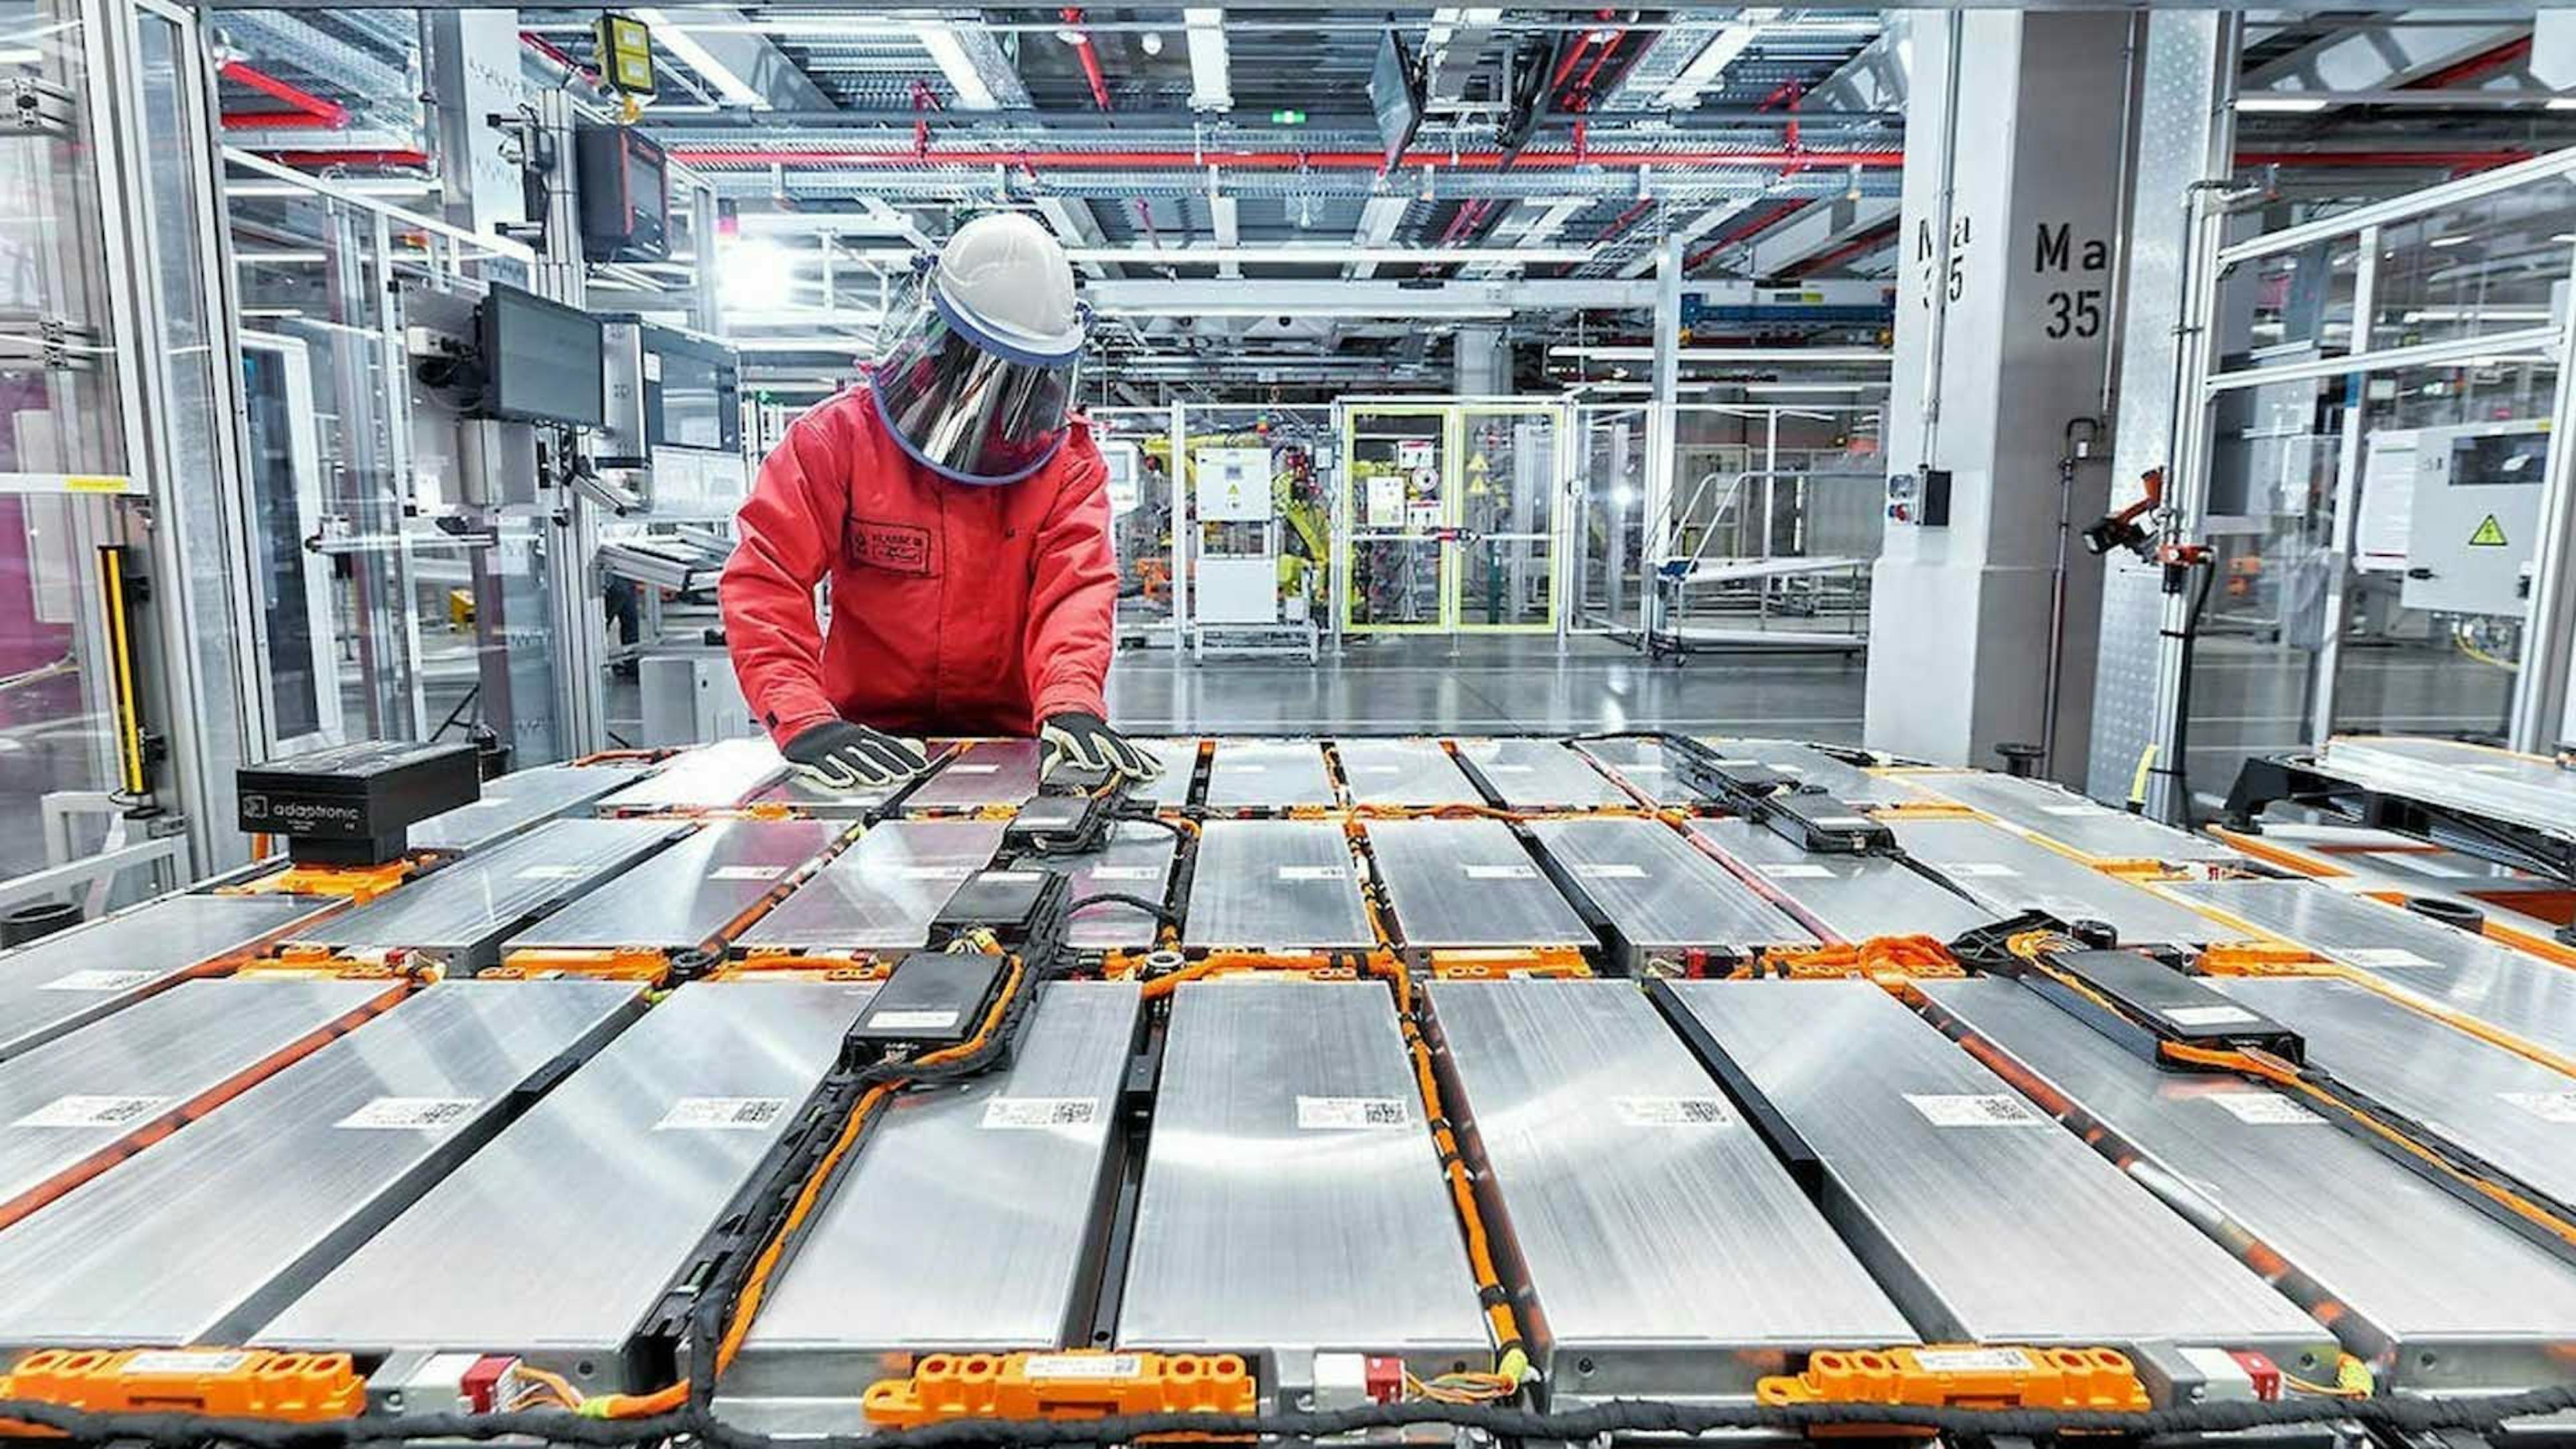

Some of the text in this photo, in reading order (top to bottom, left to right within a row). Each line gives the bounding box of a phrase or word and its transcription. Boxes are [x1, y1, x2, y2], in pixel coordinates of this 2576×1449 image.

[2035, 222, 2106, 273] Ma
[2045, 290, 2101, 339] 35
[272, 801, 360, 820] adaptronic
